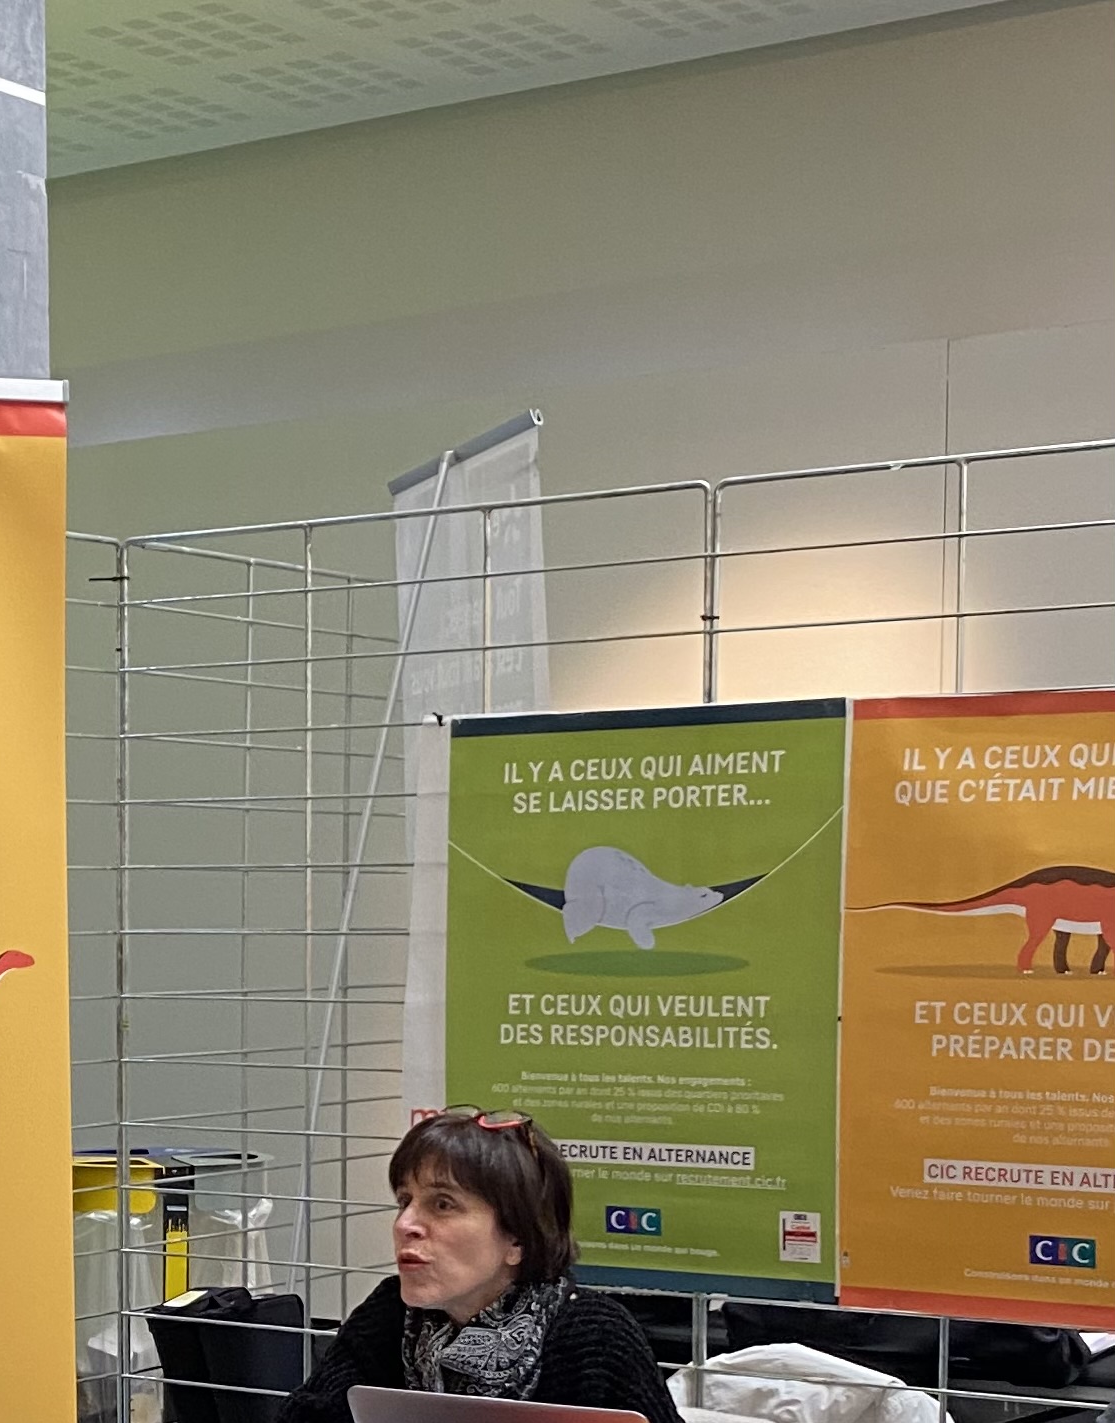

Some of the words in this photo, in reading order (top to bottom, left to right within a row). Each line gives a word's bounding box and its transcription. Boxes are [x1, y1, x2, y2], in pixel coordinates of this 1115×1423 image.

[504, 762, 523, 784] IL
[529, 761, 544, 783] Y
[548, 761, 564, 782] A
[570, 757, 633, 781] CEUX
[640, 754, 682, 781] QUI
[688, 750, 786, 776] AIMENT
[903, 748, 926, 771] IL
[934, 747, 952, 770] Y
[956, 747, 976, 770] A
[984, 744, 1060, 770] CEUX
[513, 792, 541, 814] SE
[549, 788, 645, 812] LAISSER
[653, 784, 771, 809] PORTER...
[895, 779, 950, 806] QUE
[508, 994, 535, 1015] ET
[540, 994, 602, 1017] CEUX
[609, 995, 650, 1018] QUI
[657, 995, 770, 1018] VEULENT
[914, 1001, 946, 1024] ET
[953, 1002, 1027, 1028] CEUX
[1036, 1004, 1085, 1030] QUI
[500, 1023, 543, 1045] DES
[550, 1021, 778, 1049] RESPONSABILITÉS.
[931, 1030, 1073, 1062] PRÉPARER
[560, 1143, 618, 1161] ECRUTE
[623, 1145, 643, 1161] EN
[647, 1147, 752, 1166] ALTERNANCE
[927, 1163, 957, 1180] CIC
[963, 1165, 1044, 1185] RECRUTE
[1050, 1170, 1074, 1187] EN
[1034, 1239, 1091, 1265] CIC
